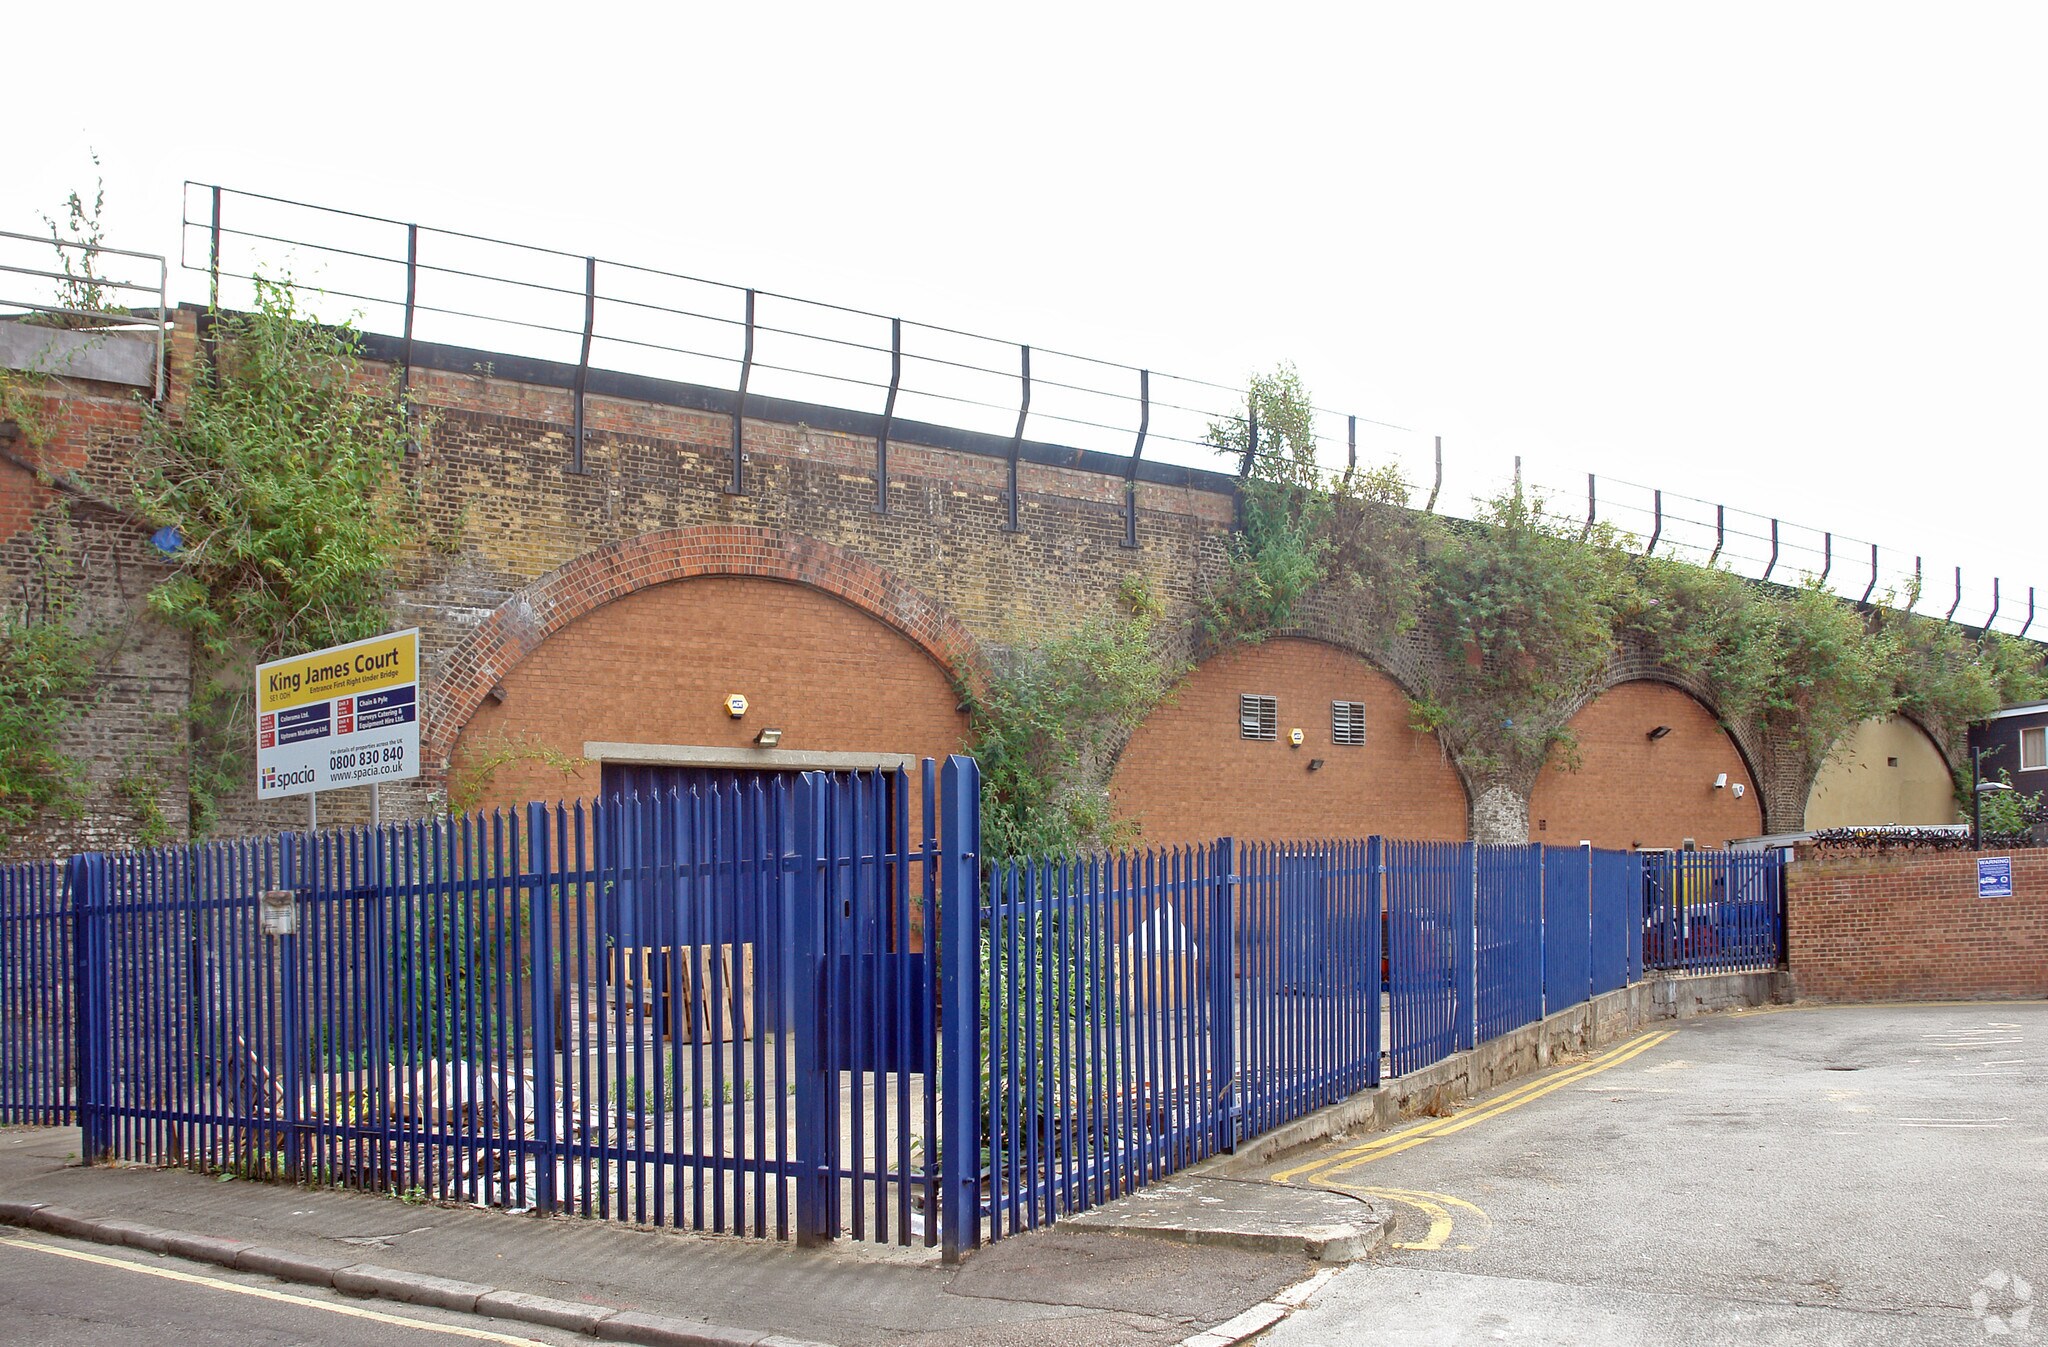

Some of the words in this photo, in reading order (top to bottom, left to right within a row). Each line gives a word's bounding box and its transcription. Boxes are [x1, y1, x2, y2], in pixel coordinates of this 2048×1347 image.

[270, 672, 300, 692] King
[305, 662, 349, 684] James
[355, 648, 399, 673] Court
[310, 684, 332, 694] Entrance
[333, 681, 345, 690] First
[346, 678, 361, 687] Right
[362, 674, 379, 683] Under
[380, 670, 399, 679] Bridge
[378, 696, 388, 705] Pyle
[359, 720, 384, 729] Equipment
[384, 717, 394, 725] Hire
[377, 709, 397, 718] Catering
[297, 727, 319, 736] Marketing
[330, 753, 356, 770] 0800
[359, 750, 379, 766] 830
[383, 745, 404, 762] 840
[277, 765, 315, 790] spacia
[330, 761, 403, 782] www.spacia.co.uk
